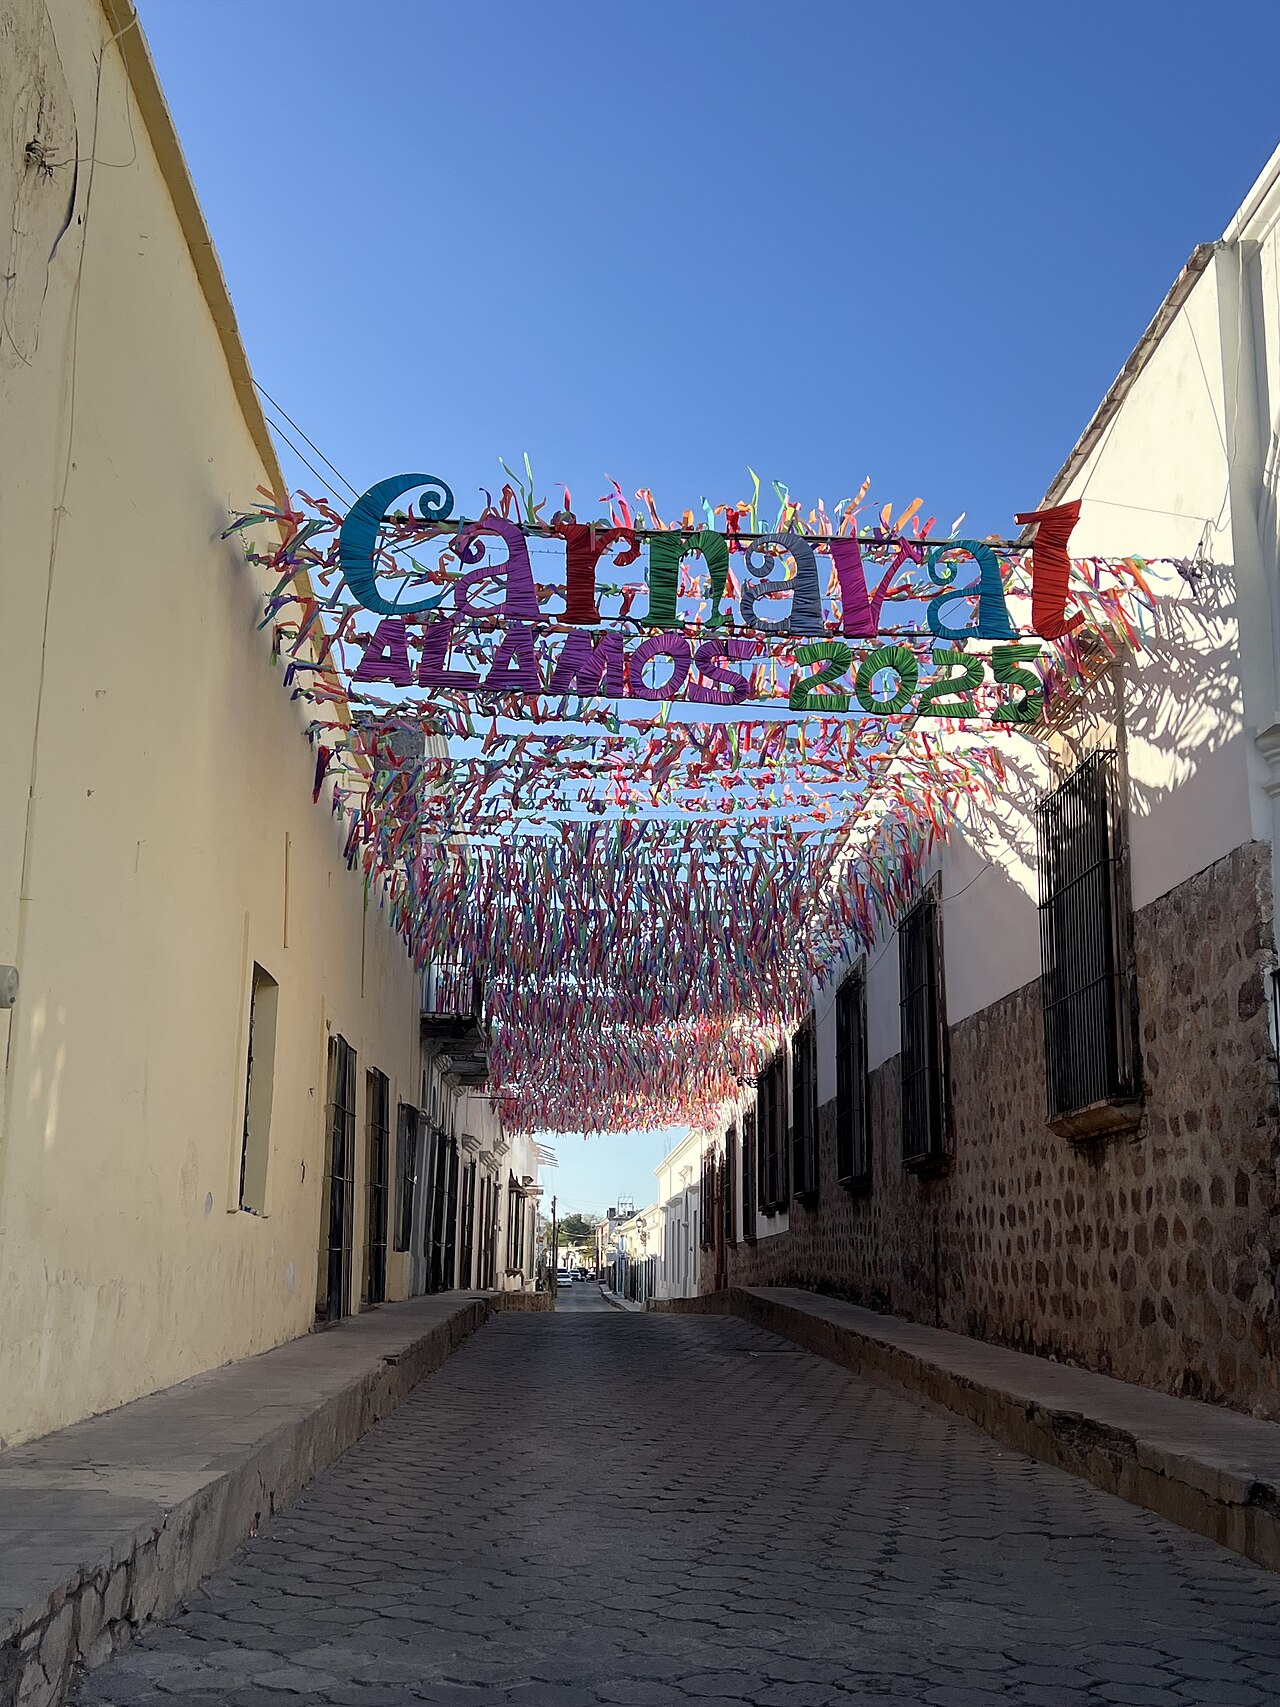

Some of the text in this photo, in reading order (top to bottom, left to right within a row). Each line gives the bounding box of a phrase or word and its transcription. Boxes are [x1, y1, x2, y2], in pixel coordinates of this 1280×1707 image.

[340, 473, 1085, 640] Carnaval
[353, 619, 1044, 723] ALAMOS 2025
